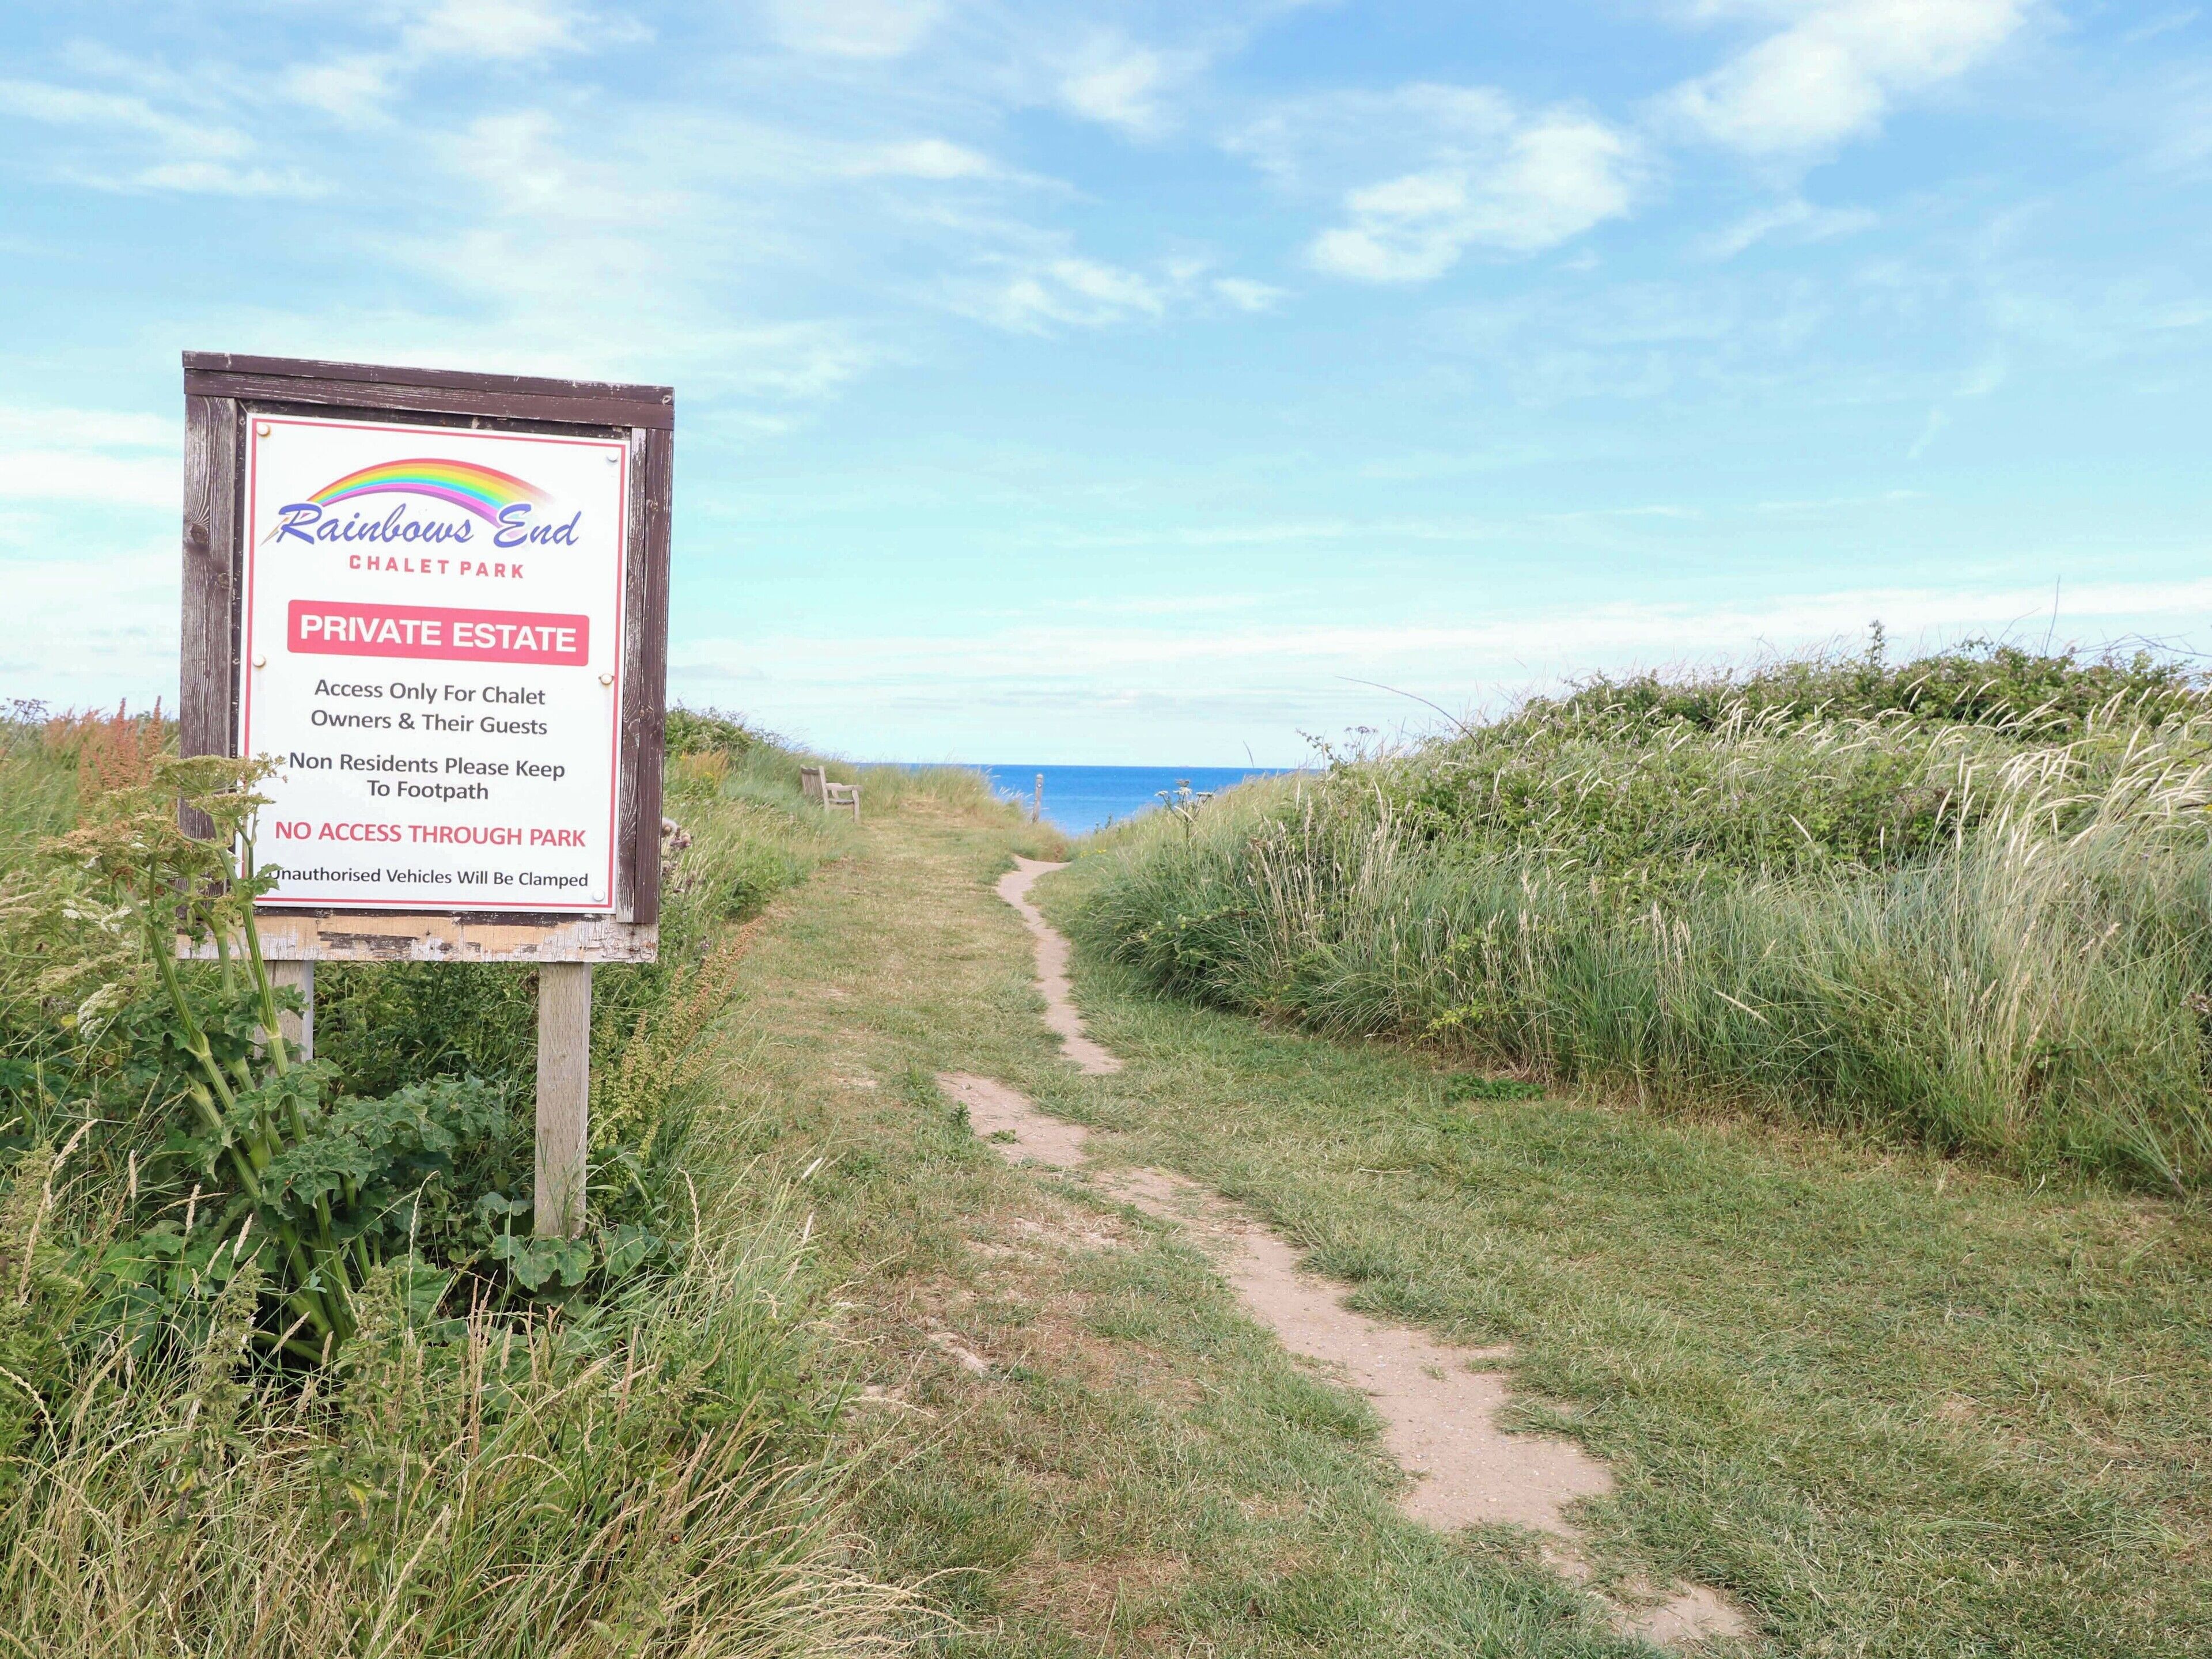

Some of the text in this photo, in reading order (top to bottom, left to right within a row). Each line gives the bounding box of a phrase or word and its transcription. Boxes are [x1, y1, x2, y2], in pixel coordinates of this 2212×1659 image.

[276, 502, 582, 548] Rainbows End
[350, 555, 523, 579] CHALET PARK
[301, 614, 577, 652] PRIVATE ESTATE
[315, 679, 546, 705] Access Only For Chalet
[311, 709, 547, 735] Owners & Their Guests
[290, 752, 565, 782] Non Residents Please Keep
[366, 779, 488, 803] To Footpath
[275, 821, 586, 847] NO ACCESS THROUGH PARK
[386, 869, 452, 884] Vehicles
[457, 870, 488, 885] Will
[494, 872, 514, 885] Be
[518, 872, 588, 889] Clamped
